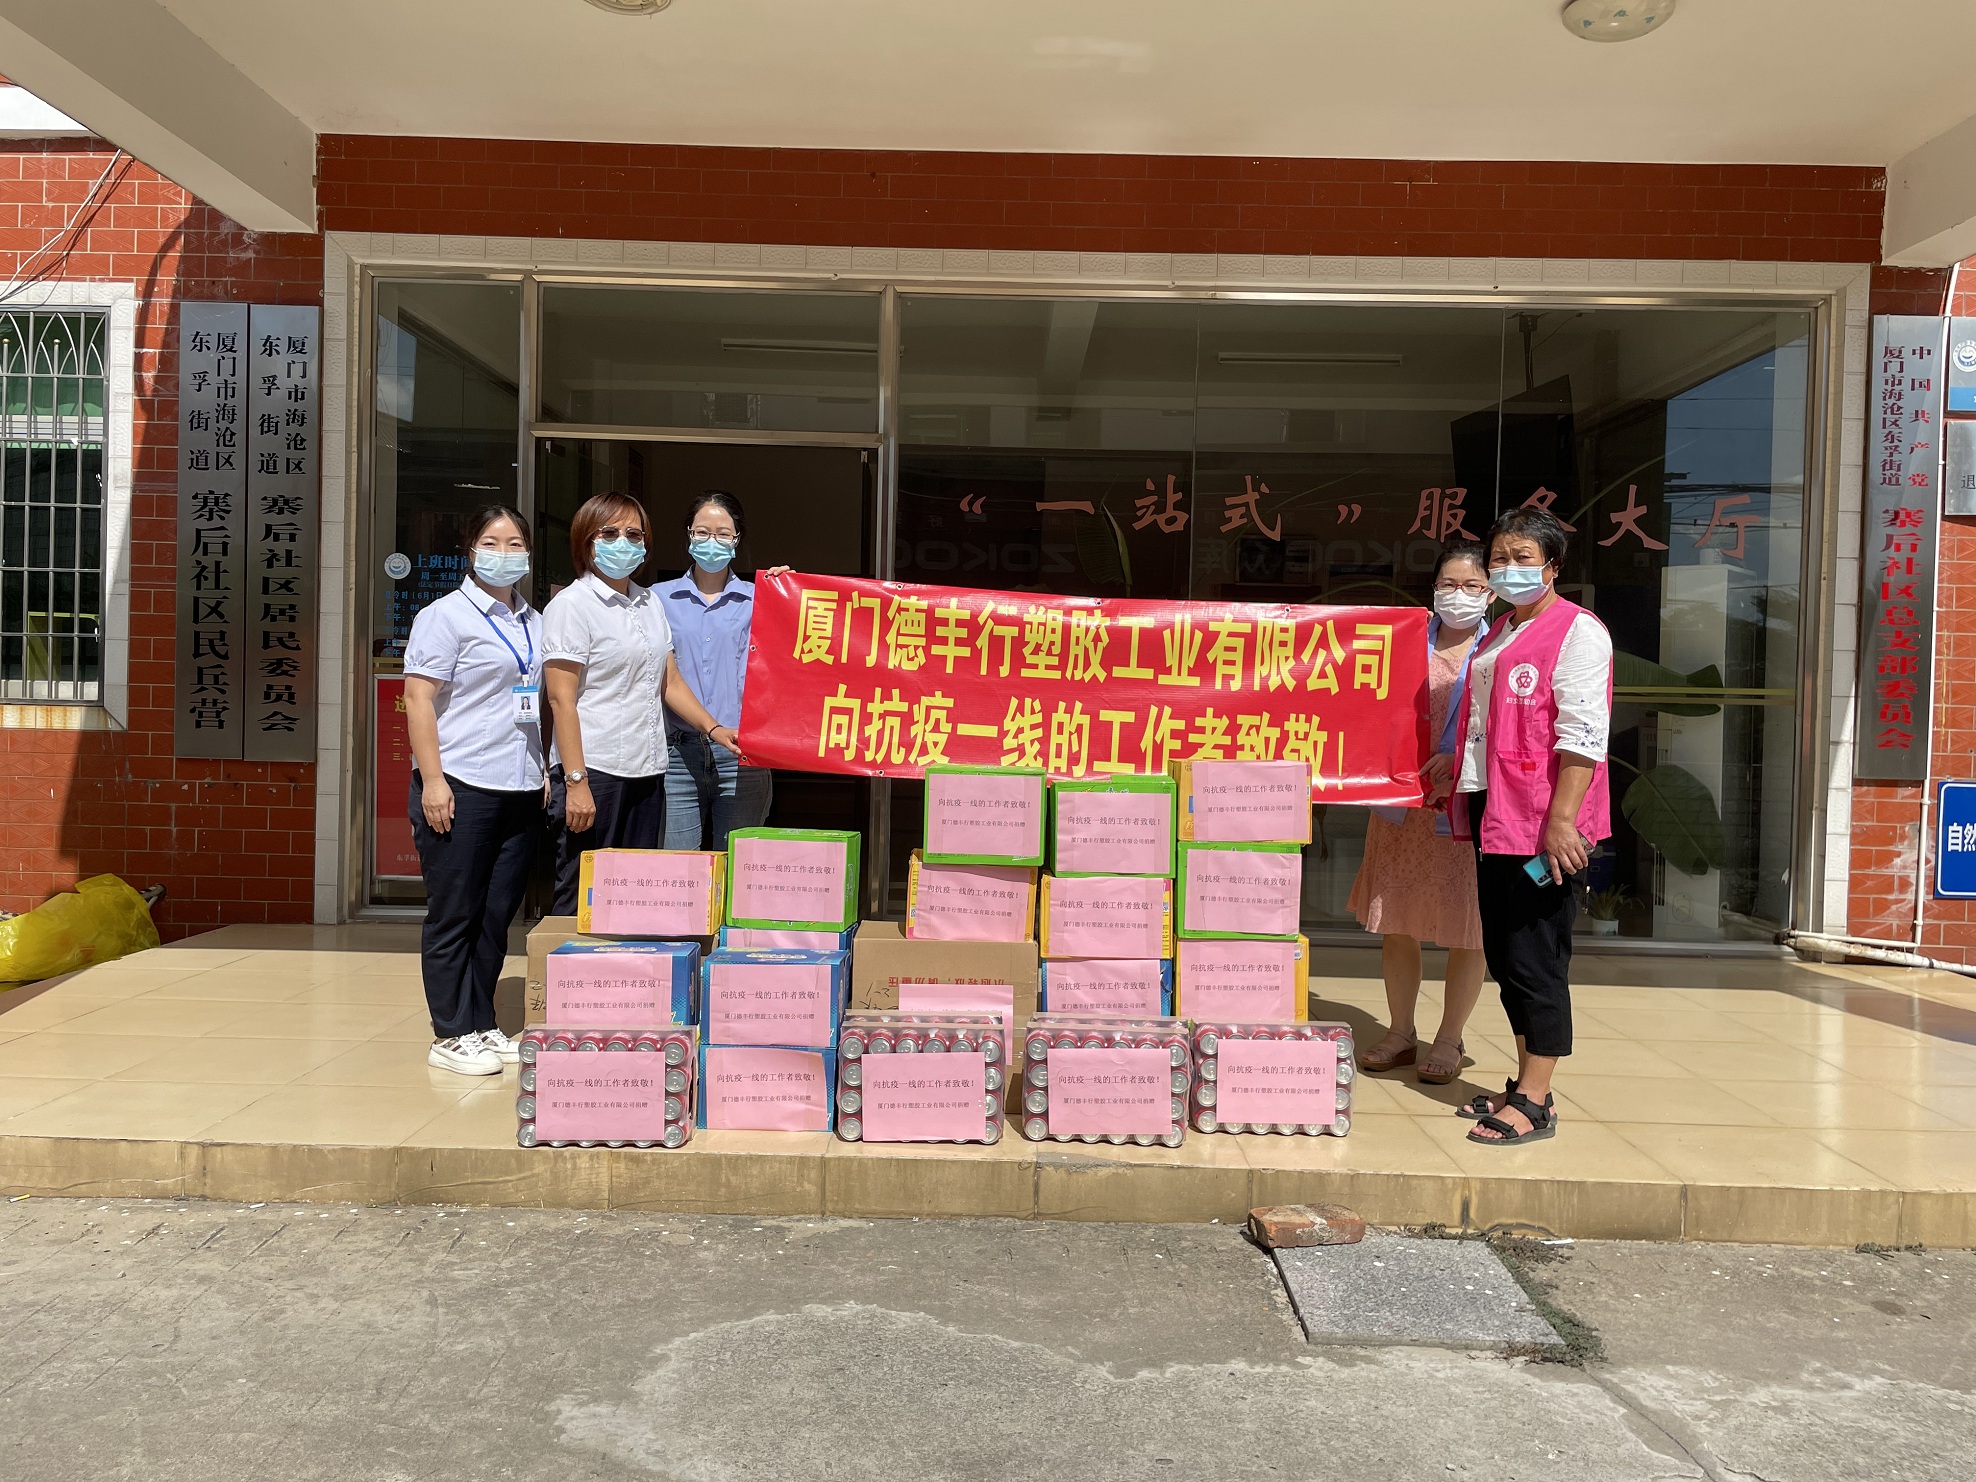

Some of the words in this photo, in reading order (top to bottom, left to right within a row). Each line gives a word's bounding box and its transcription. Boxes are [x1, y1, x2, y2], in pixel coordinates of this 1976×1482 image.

[187, 330, 212, 471] 东孚街道
[214, 331, 238, 471] 厦门市海沧区
[257, 334, 281, 475] 东孚街道
[285, 335, 309, 475] 厦门市海沧区
[1879, 345, 1905, 487] 厦门市海沧区东孚街道
[1907, 345, 1931, 487] 中国共产党
[189, 489, 233, 730] 寨后社区民兵营
[257, 494, 304, 732] 寨后社区居民委员会
[793, 588, 1393, 700] 厦门德丰行塑胶工业有限公司
[1875, 506, 1925, 749] 寨后社区总支部委员会
[1948, 822, 1976, 852] 自然
